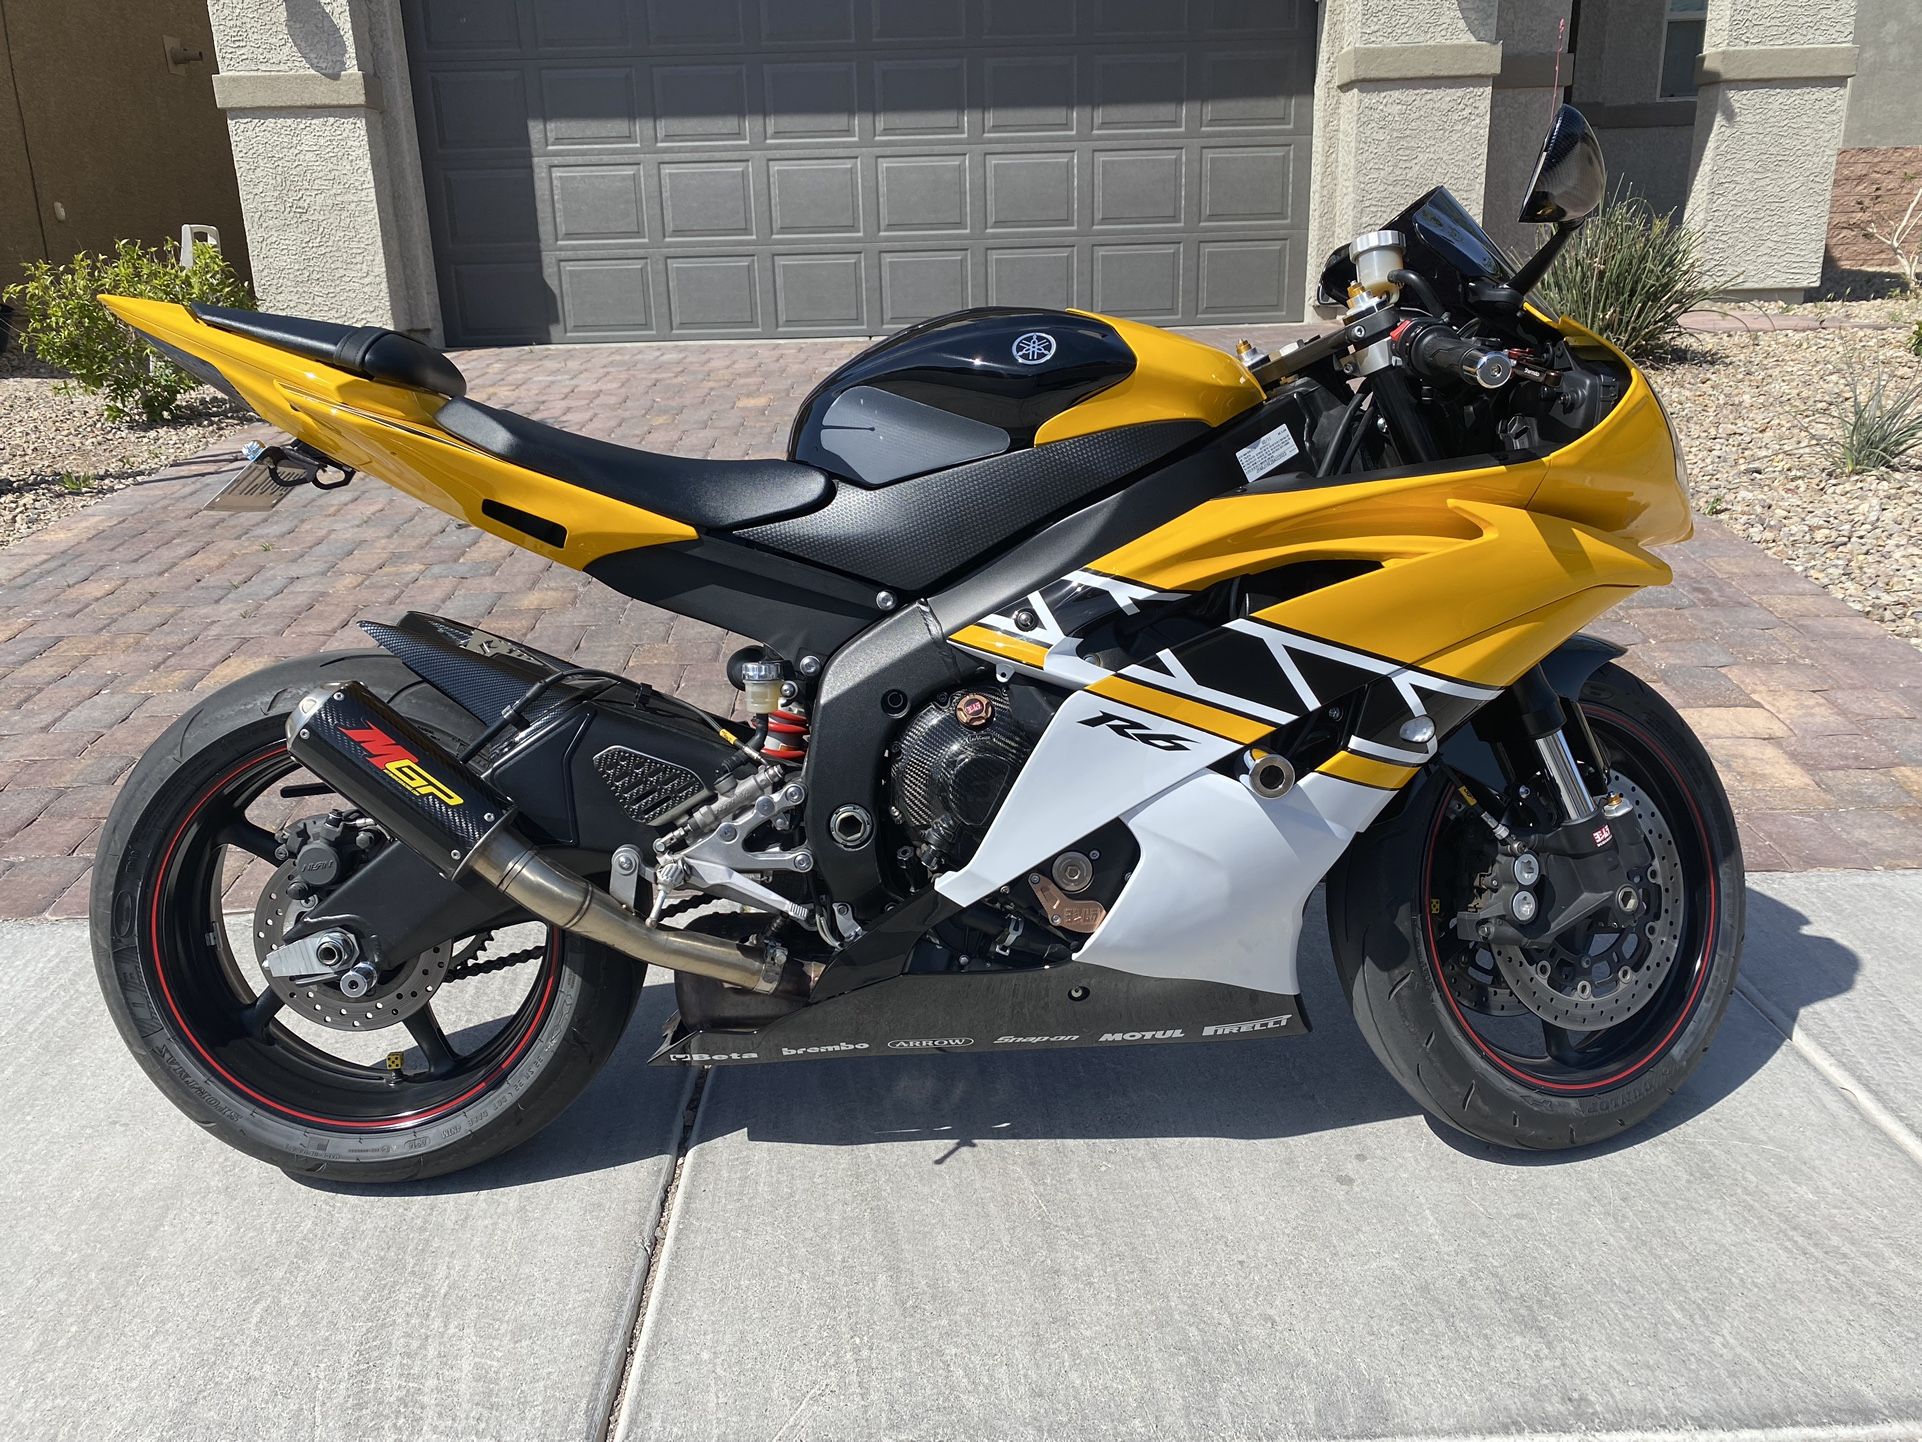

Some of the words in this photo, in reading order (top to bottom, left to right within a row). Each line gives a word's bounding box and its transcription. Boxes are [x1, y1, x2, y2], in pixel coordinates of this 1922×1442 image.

[1076, 710, 1201, 751] R6
[1202, 1014, 1293, 1036] PIRELLI
[993, 1035, 1079, 1043] Snap-on
[1099, 1029, 1185, 1042] MOTUL
[782, 1042, 869, 1055] brembo
[895, 1038, 965, 1047] ARROW
